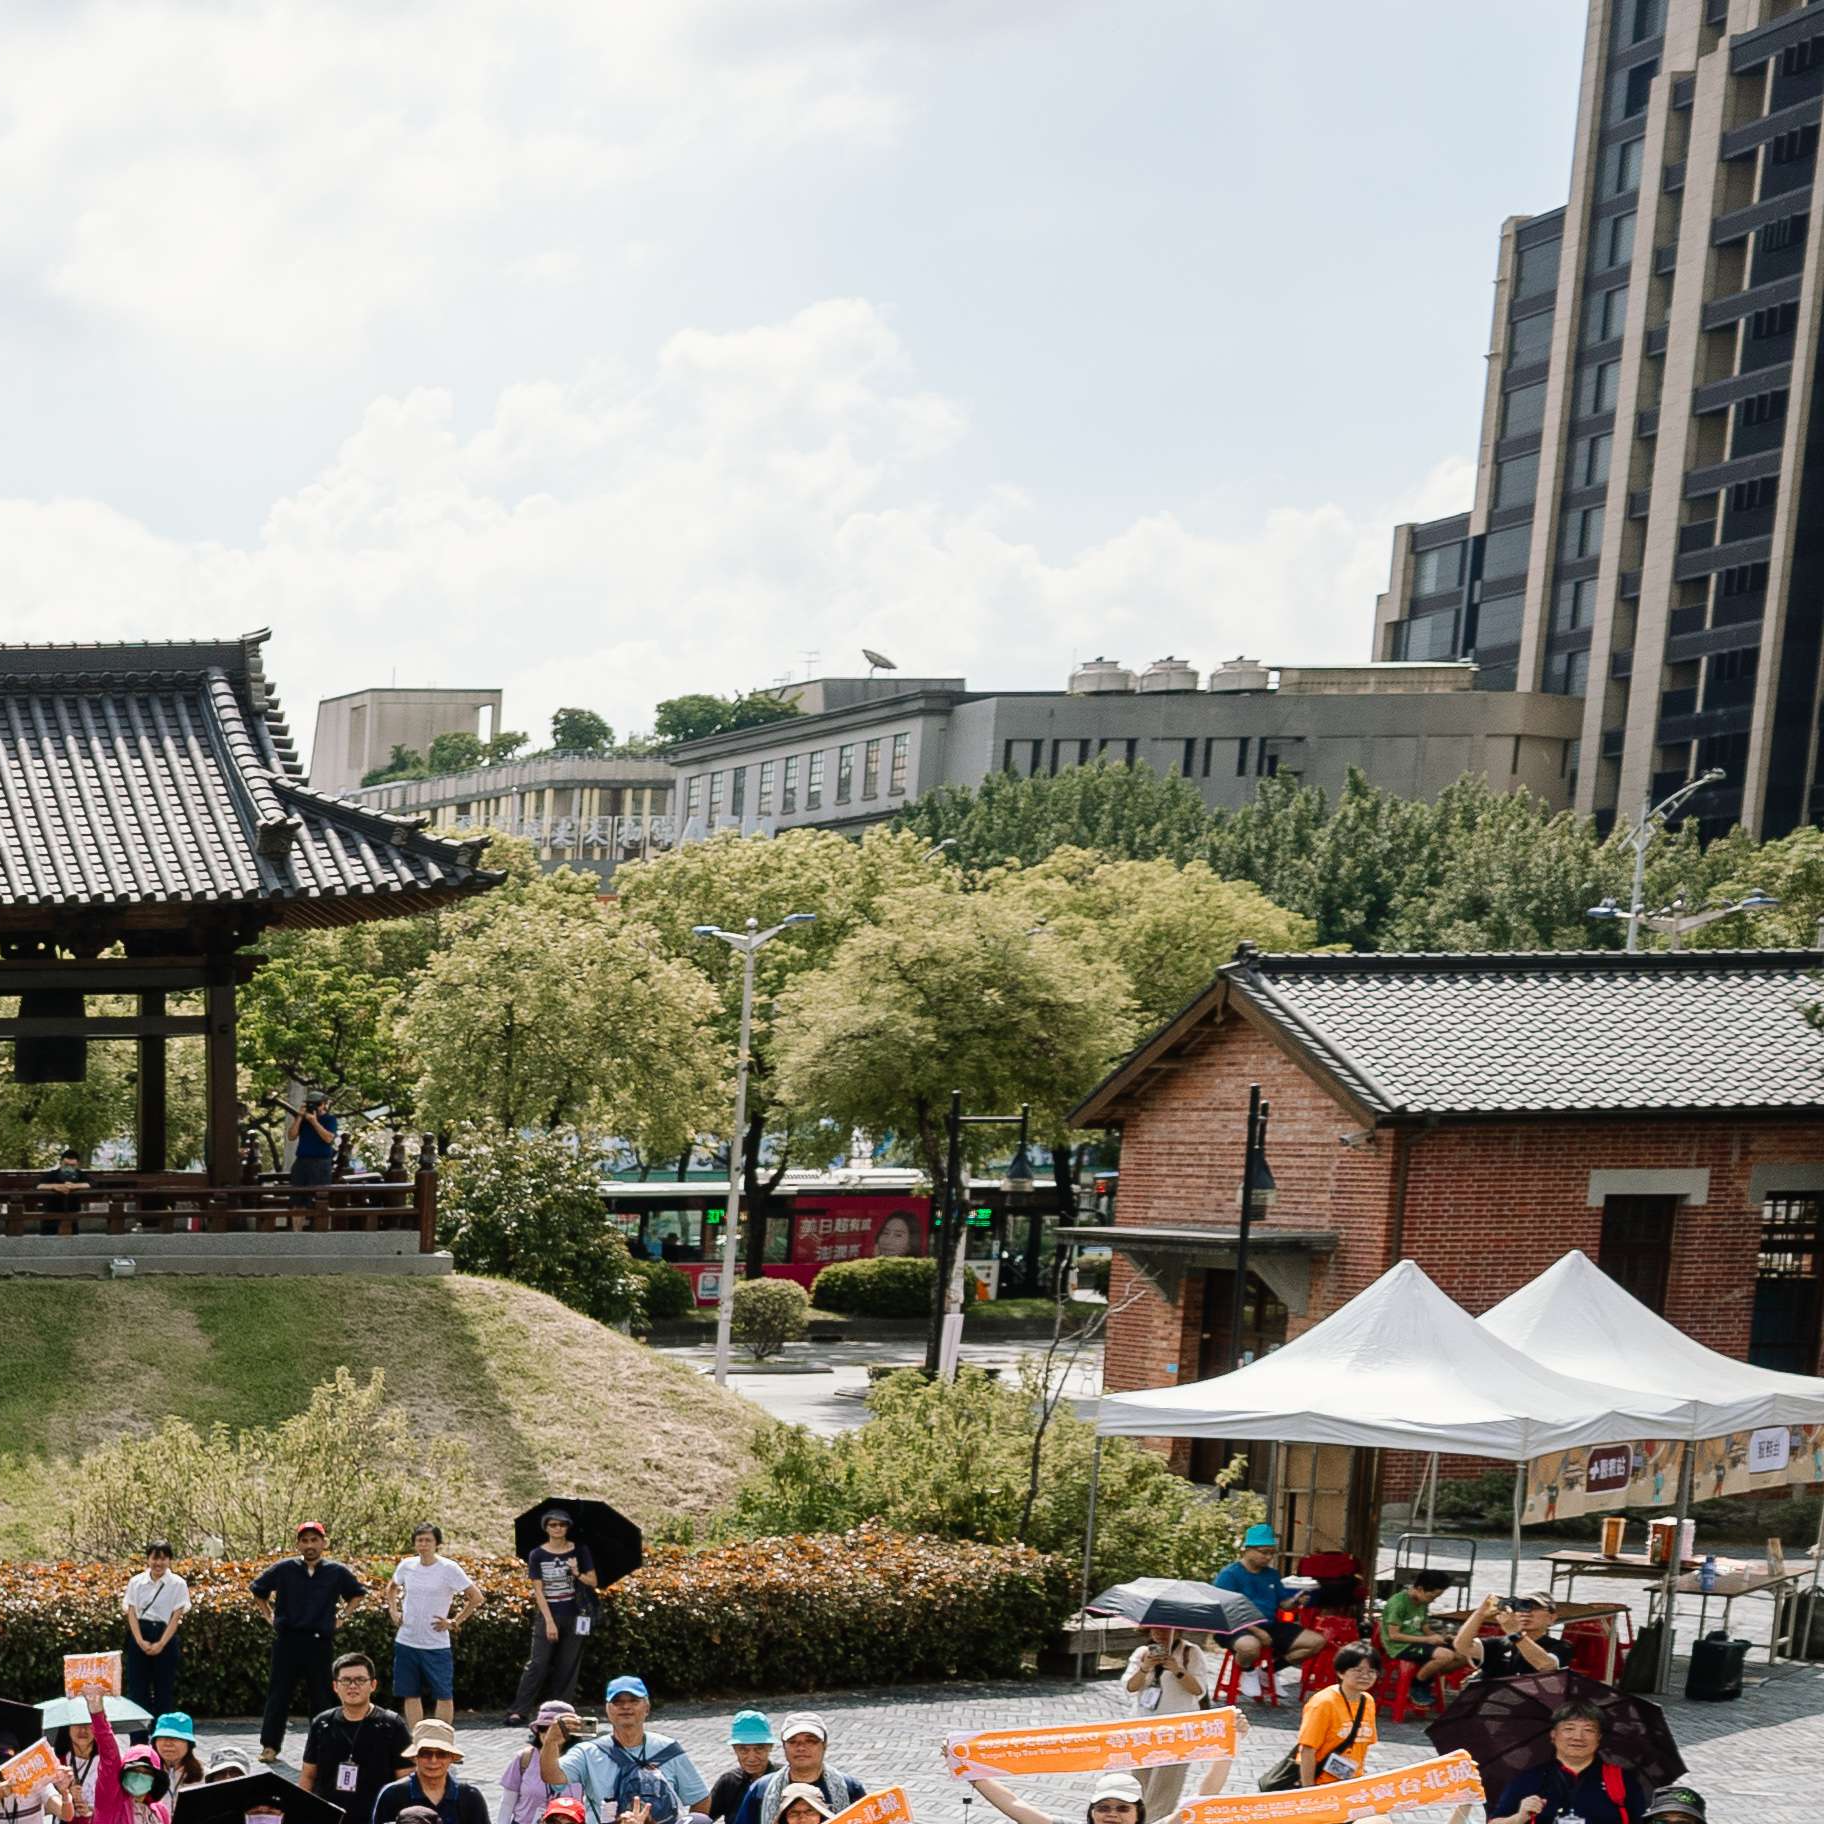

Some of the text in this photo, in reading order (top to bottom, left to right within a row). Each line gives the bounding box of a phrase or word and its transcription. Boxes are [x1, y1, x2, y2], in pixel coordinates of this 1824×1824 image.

[1106, 1719, 1226, 1748] 尋寶台北城
